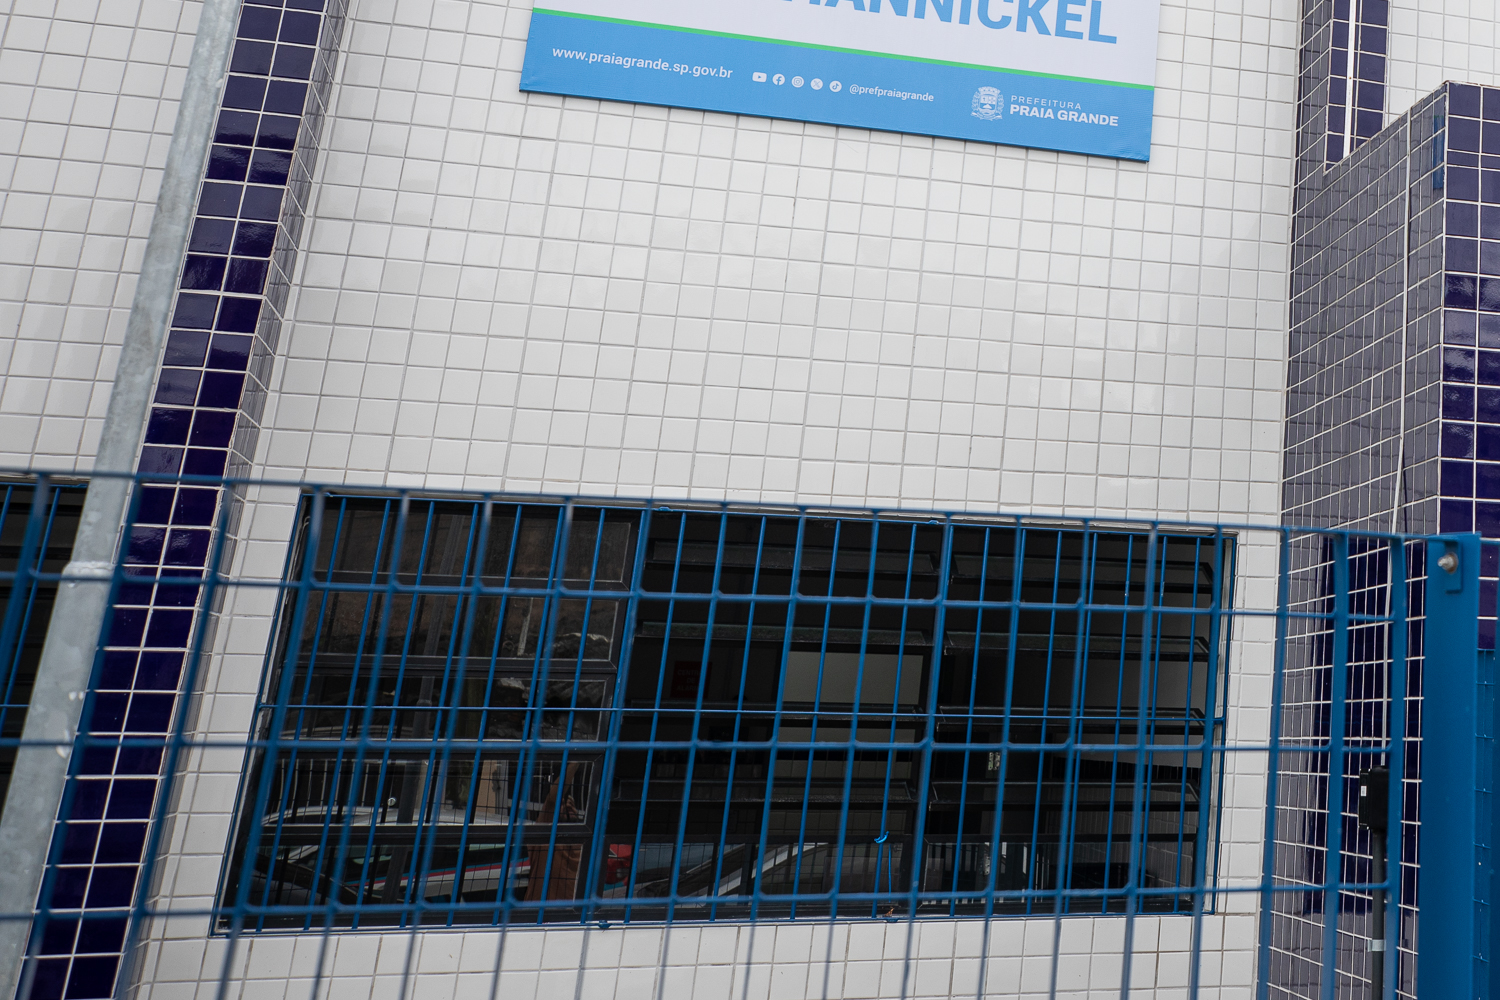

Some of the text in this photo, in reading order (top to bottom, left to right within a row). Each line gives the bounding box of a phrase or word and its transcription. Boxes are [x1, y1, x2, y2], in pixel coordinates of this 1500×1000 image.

[552, 48, 734, 79] www.praiagrande.sp.gov.br
[849, 83, 935, 102] @prefpraiagrande
[1010, 94, 1082, 110] PREFEITURA
[1009, 103, 1120, 127] PRAIA GRANDE
